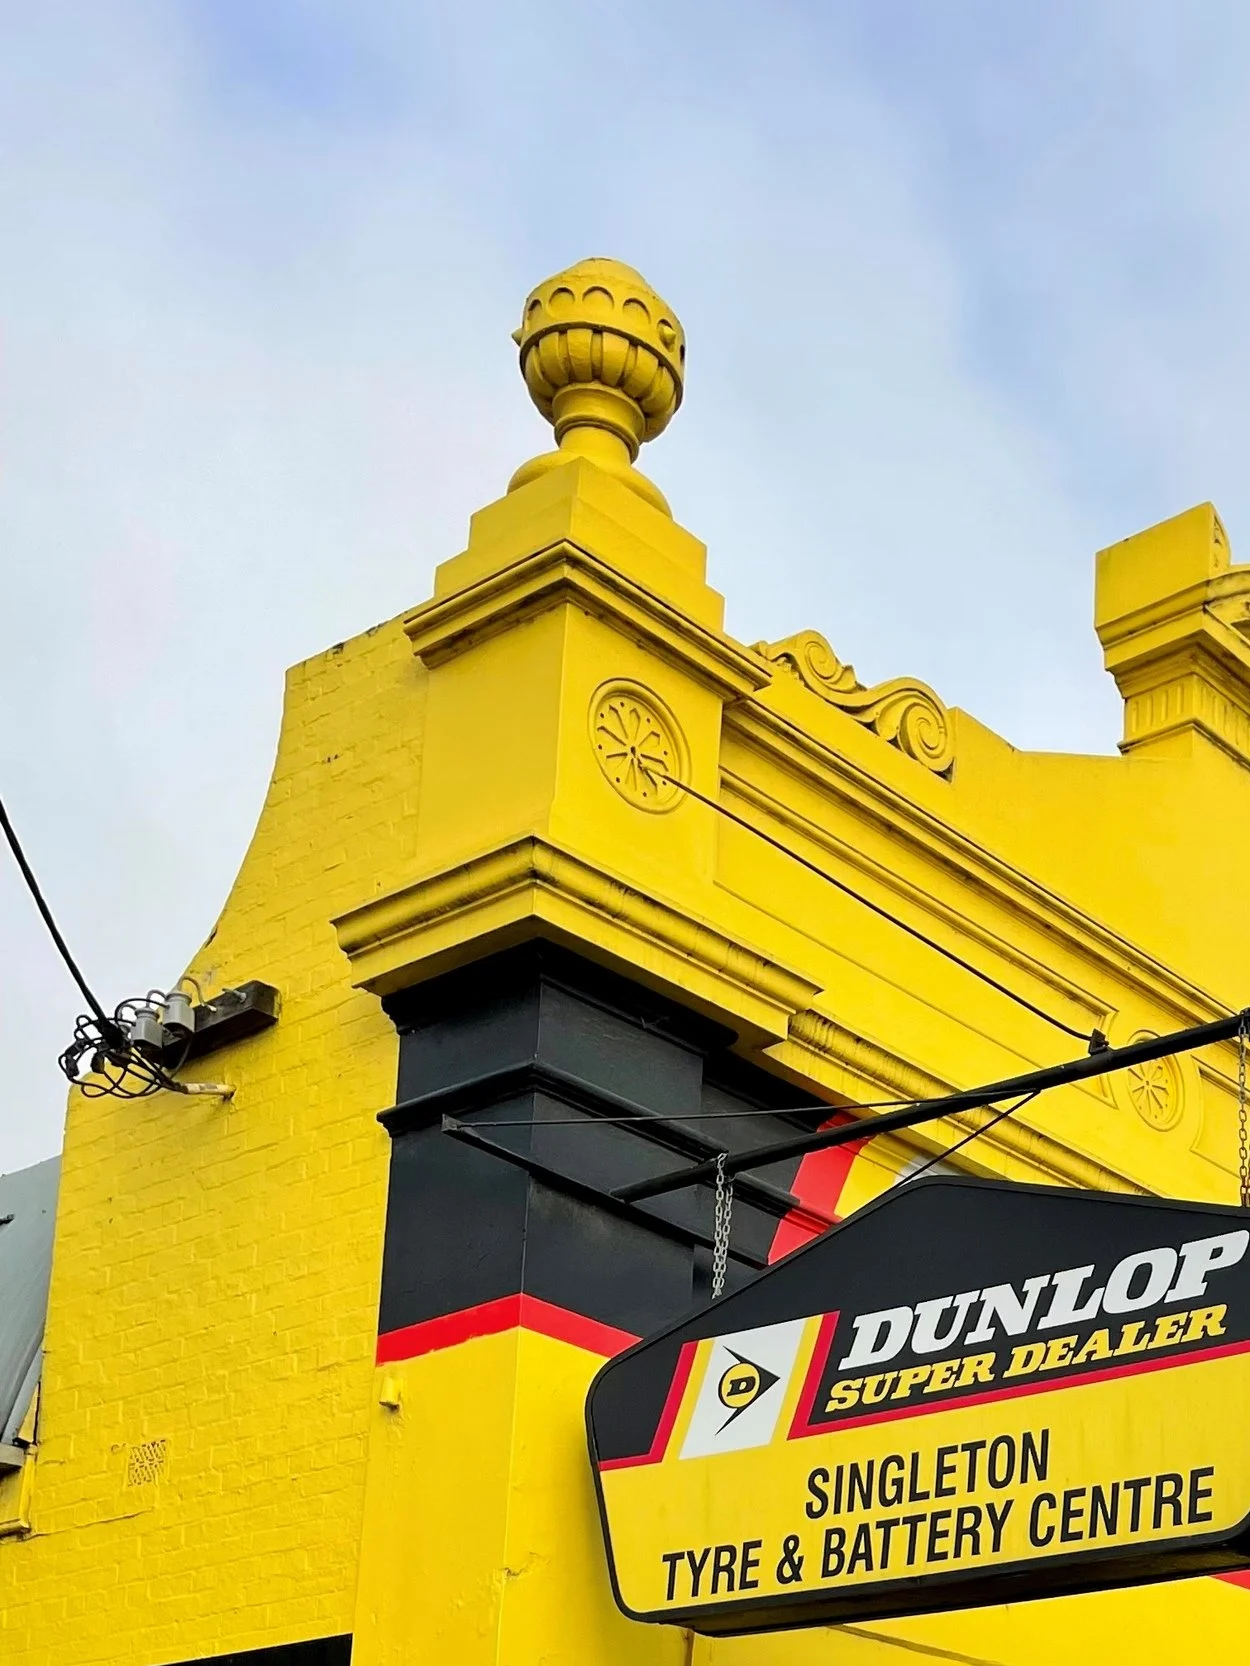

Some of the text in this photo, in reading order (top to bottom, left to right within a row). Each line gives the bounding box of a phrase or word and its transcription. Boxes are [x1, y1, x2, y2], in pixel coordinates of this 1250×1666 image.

[825, 1304, 1227, 1413] SUPER DEALER
[838, 1229, 1250, 1371] DUNLOP
[662, 1466, 1214, 1601] TYRE & BATTERY CENTRE
[805, 1428, 1049, 1520] SINGLETON
